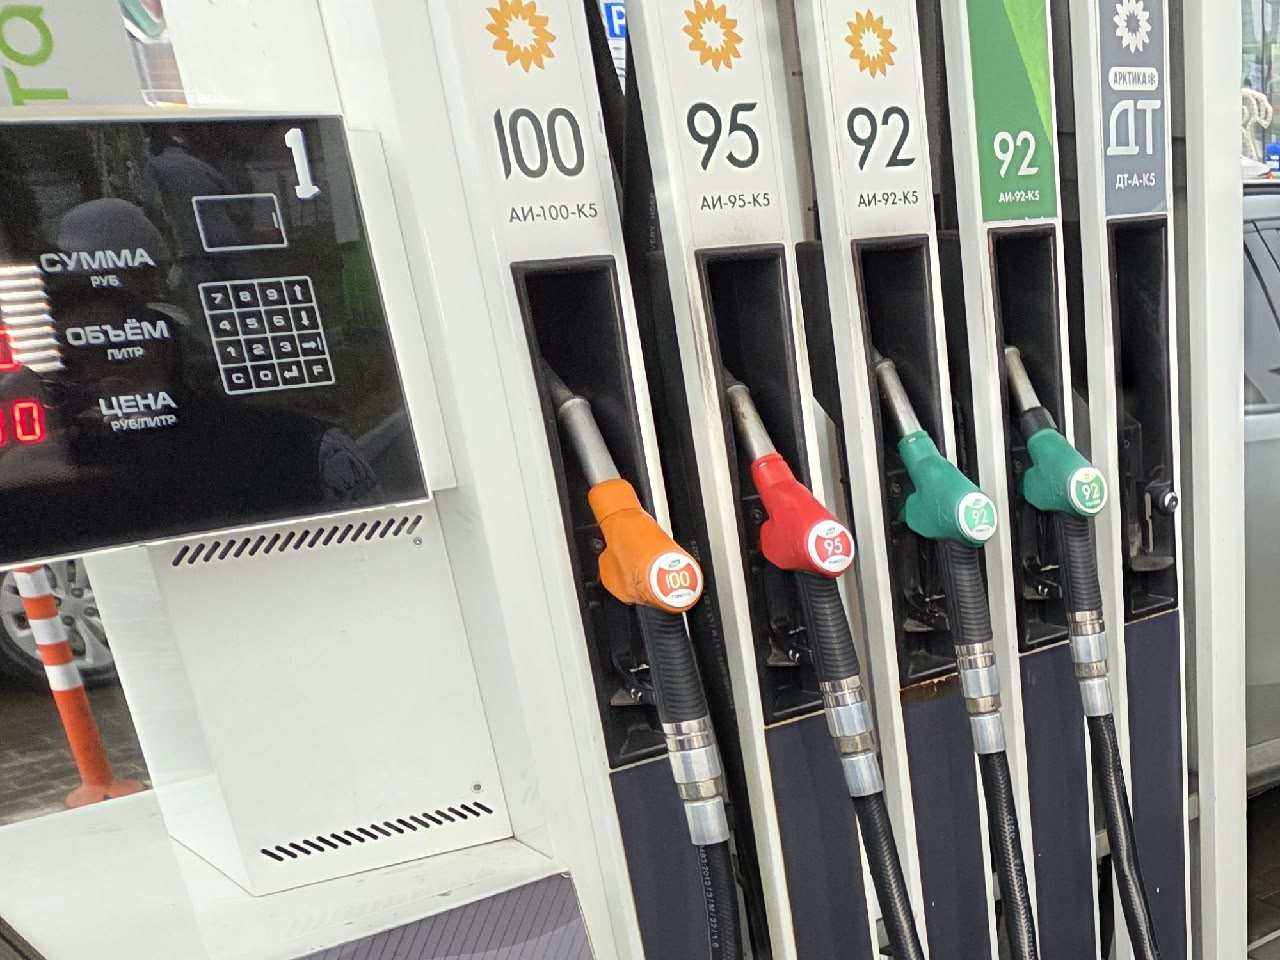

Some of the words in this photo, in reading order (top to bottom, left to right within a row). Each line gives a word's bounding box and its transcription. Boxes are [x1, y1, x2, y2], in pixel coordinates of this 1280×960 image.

[1113, 71, 1147, 86] АРКТИКА
[686, 101, 759, 171] 95
[1106, 99, 1162, 156] ДТ
[493, 107, 585, 180] 100
[846, 105, 916, 171] 92
[285, 128, 320, 198] 1
[993, 130, 1039, 178] 92
[1115, 172, 1156, 190] ДТ-А-К5
[700, 192, 771, 212] АИ-95-К5
[857, 190, 919, 209] АИ-92-К5
[998, 189, 1040, 203] АИ-92-К5
[509, 202, 599, 224] АИ-100-К5
[39, 248, 157, 273] СУММА
[211, 292, 223, 304] 7
[239, 290, 251, 302] 8
[266, 288, 279, 300] 9
[65, 318, 170, 346] ОБЪЁМ
[219, 319, 231, 331] 4
[246, 317, 259, 329] 5
[273, 315, 286, 327] 6
[107, 347, 145, 360] ЛИТР
[253, 343, 265, 355] 2
[280, 341, 292, 352] 3
[313, 364, 325, 376] F
[98, 391, 179, 417] ЦЕНА
[111, 414, 178, 431] РУБ/ЛИТР
[1081, 483, 1101, 500] 92
[971, 508, 989, 525] 92
[823, 537, 843, 556] 95
[665, 570, 691, 591] 100
